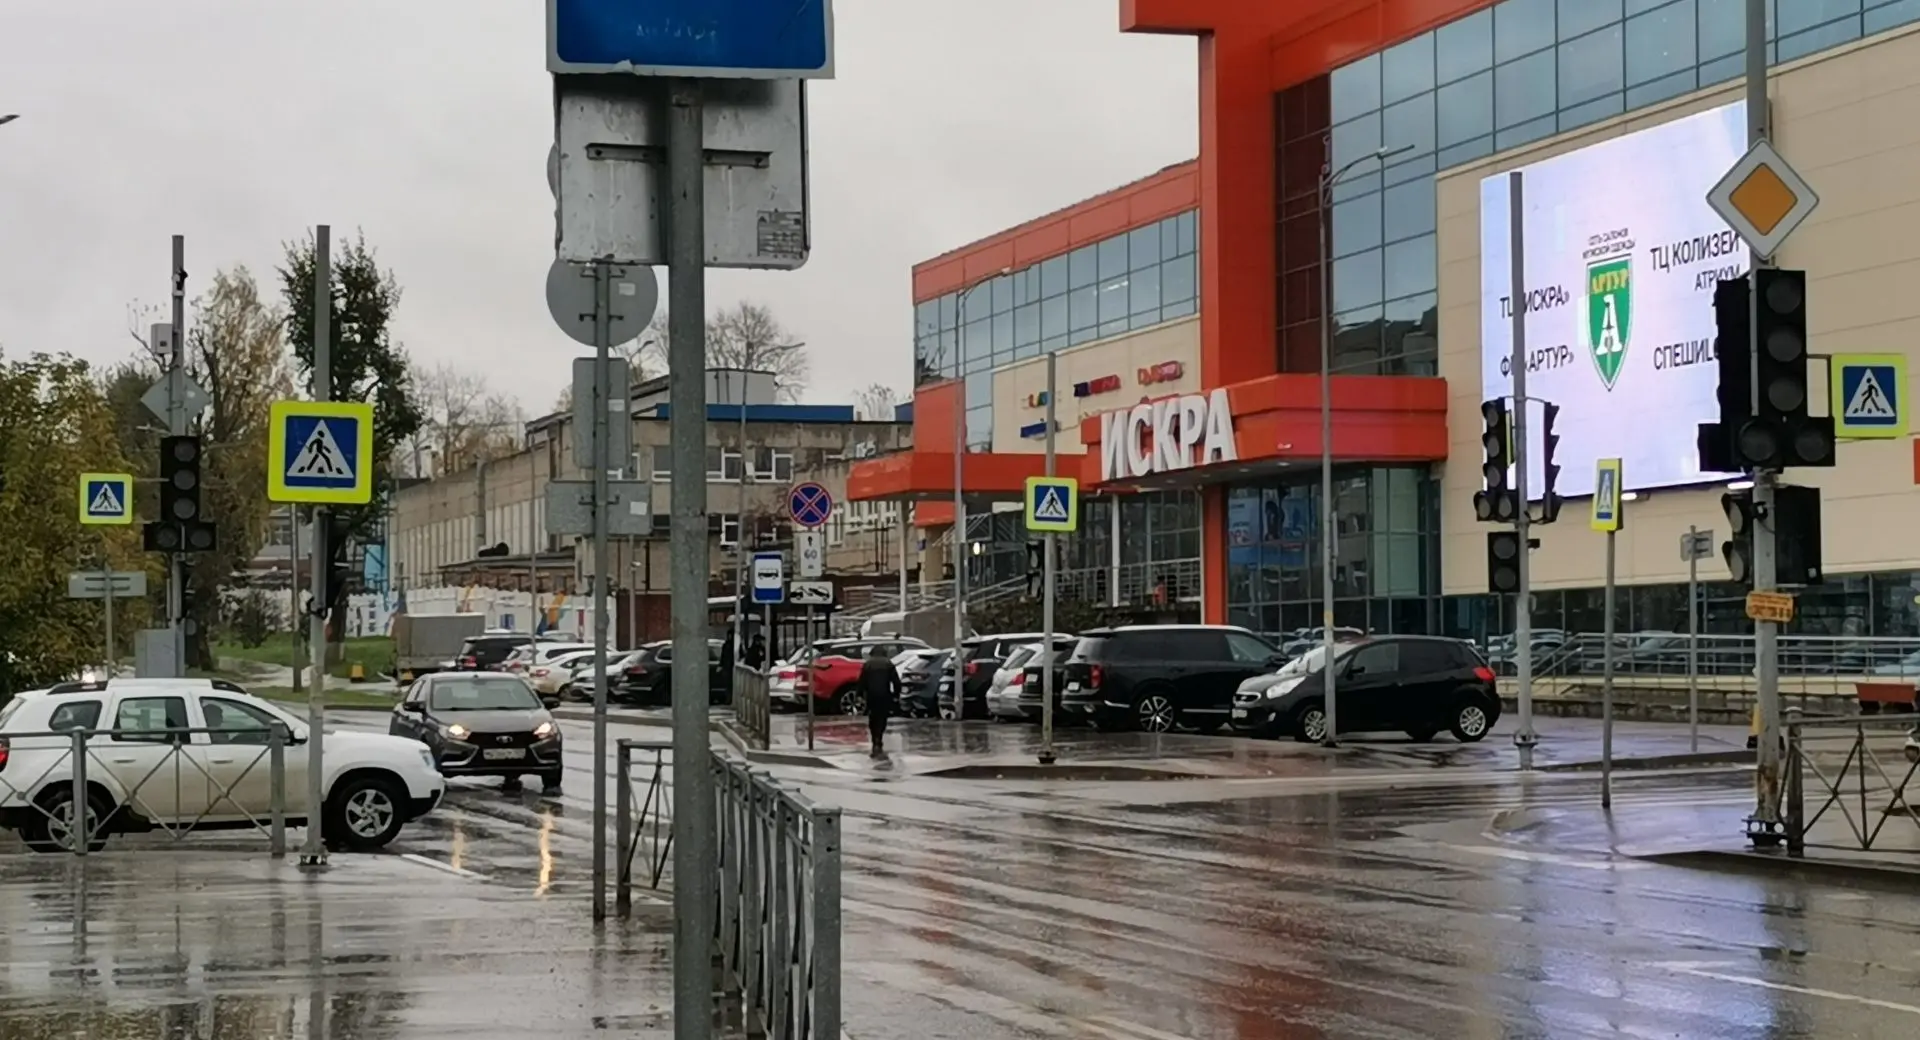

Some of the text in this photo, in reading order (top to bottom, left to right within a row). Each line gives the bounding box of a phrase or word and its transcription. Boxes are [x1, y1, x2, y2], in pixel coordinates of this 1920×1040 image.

[1650, 244, 1670, 273] ТЦ
[1523, 285, 1570, 315] ИСКРА»
[1101, 388, 1238, 482] ИСКРА
